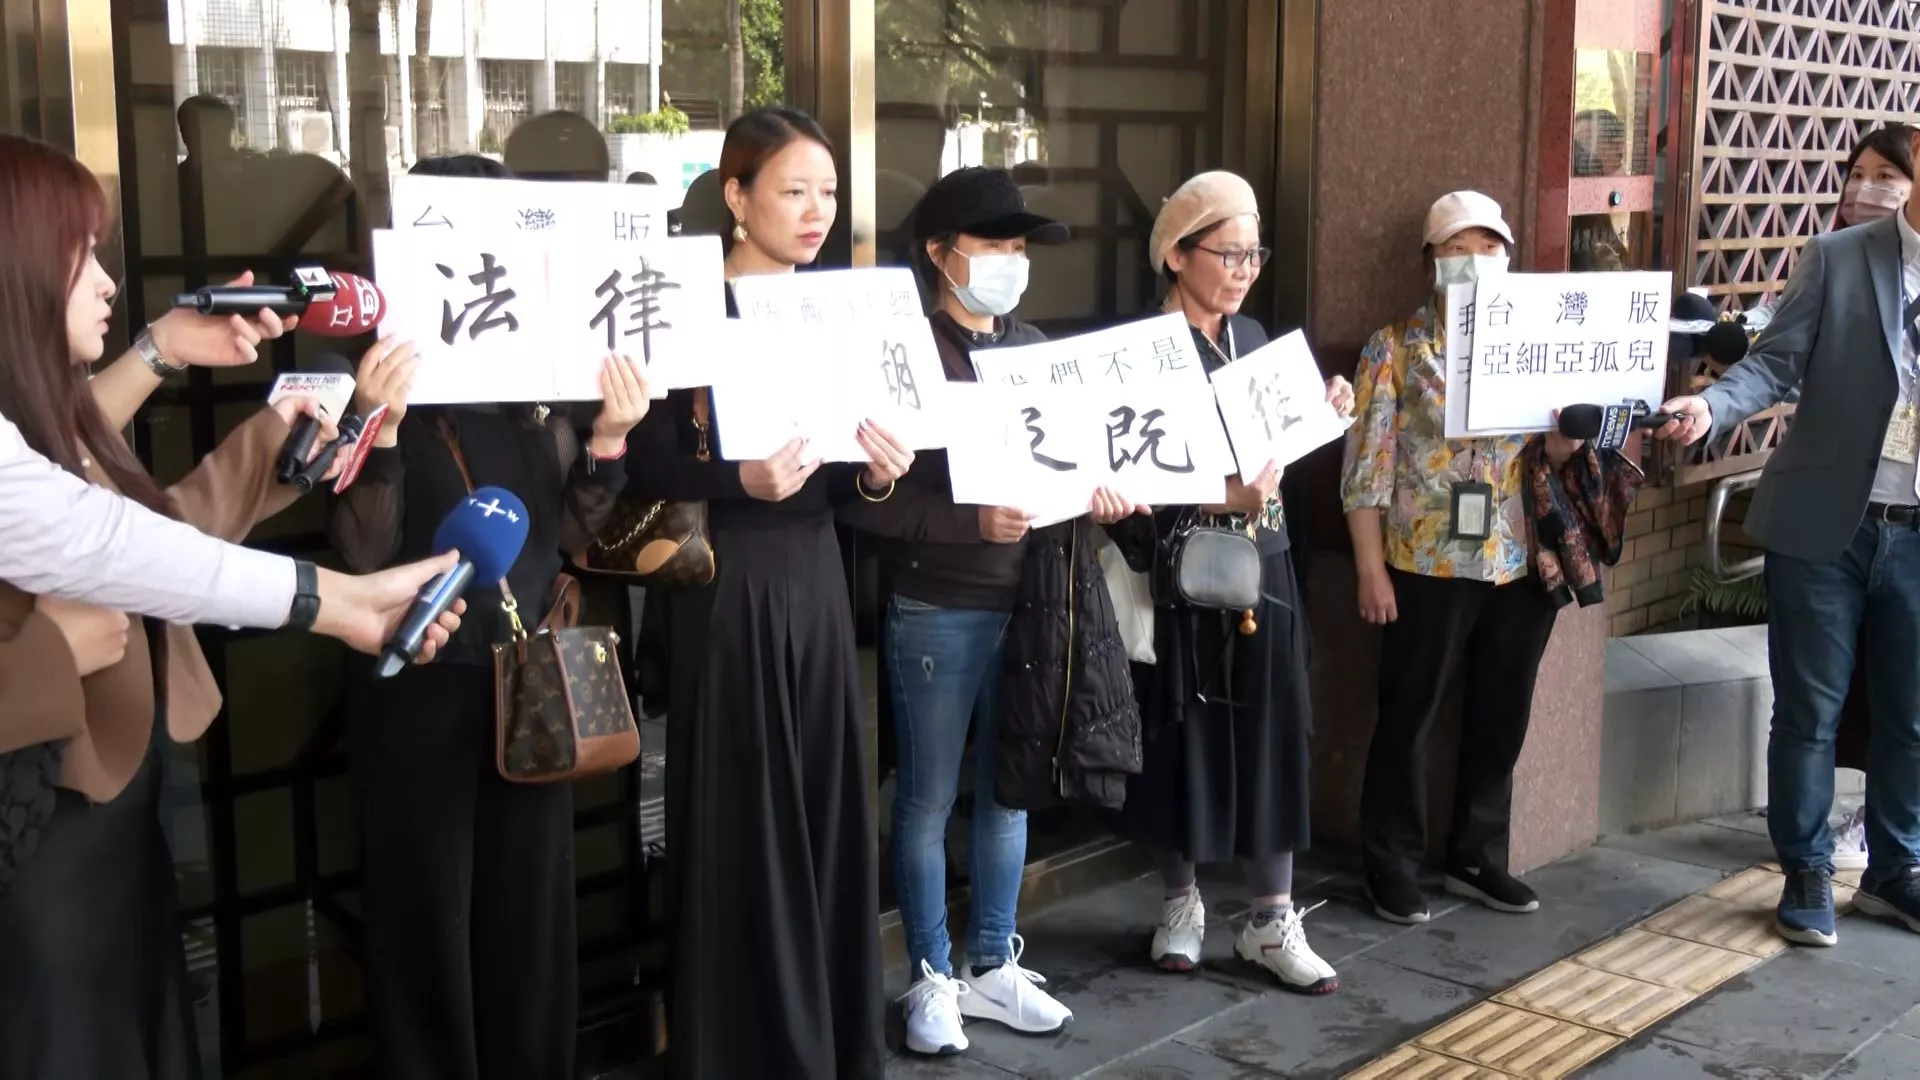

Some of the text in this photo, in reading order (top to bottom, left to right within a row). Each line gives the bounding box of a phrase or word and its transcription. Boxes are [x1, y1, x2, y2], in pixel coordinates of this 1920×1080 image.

[434, 252, 682, 366] 法律
[1486, 290, 1660, 327] 台灣版
[1480, 338, 1656, 376] 亞細亞孤兒
